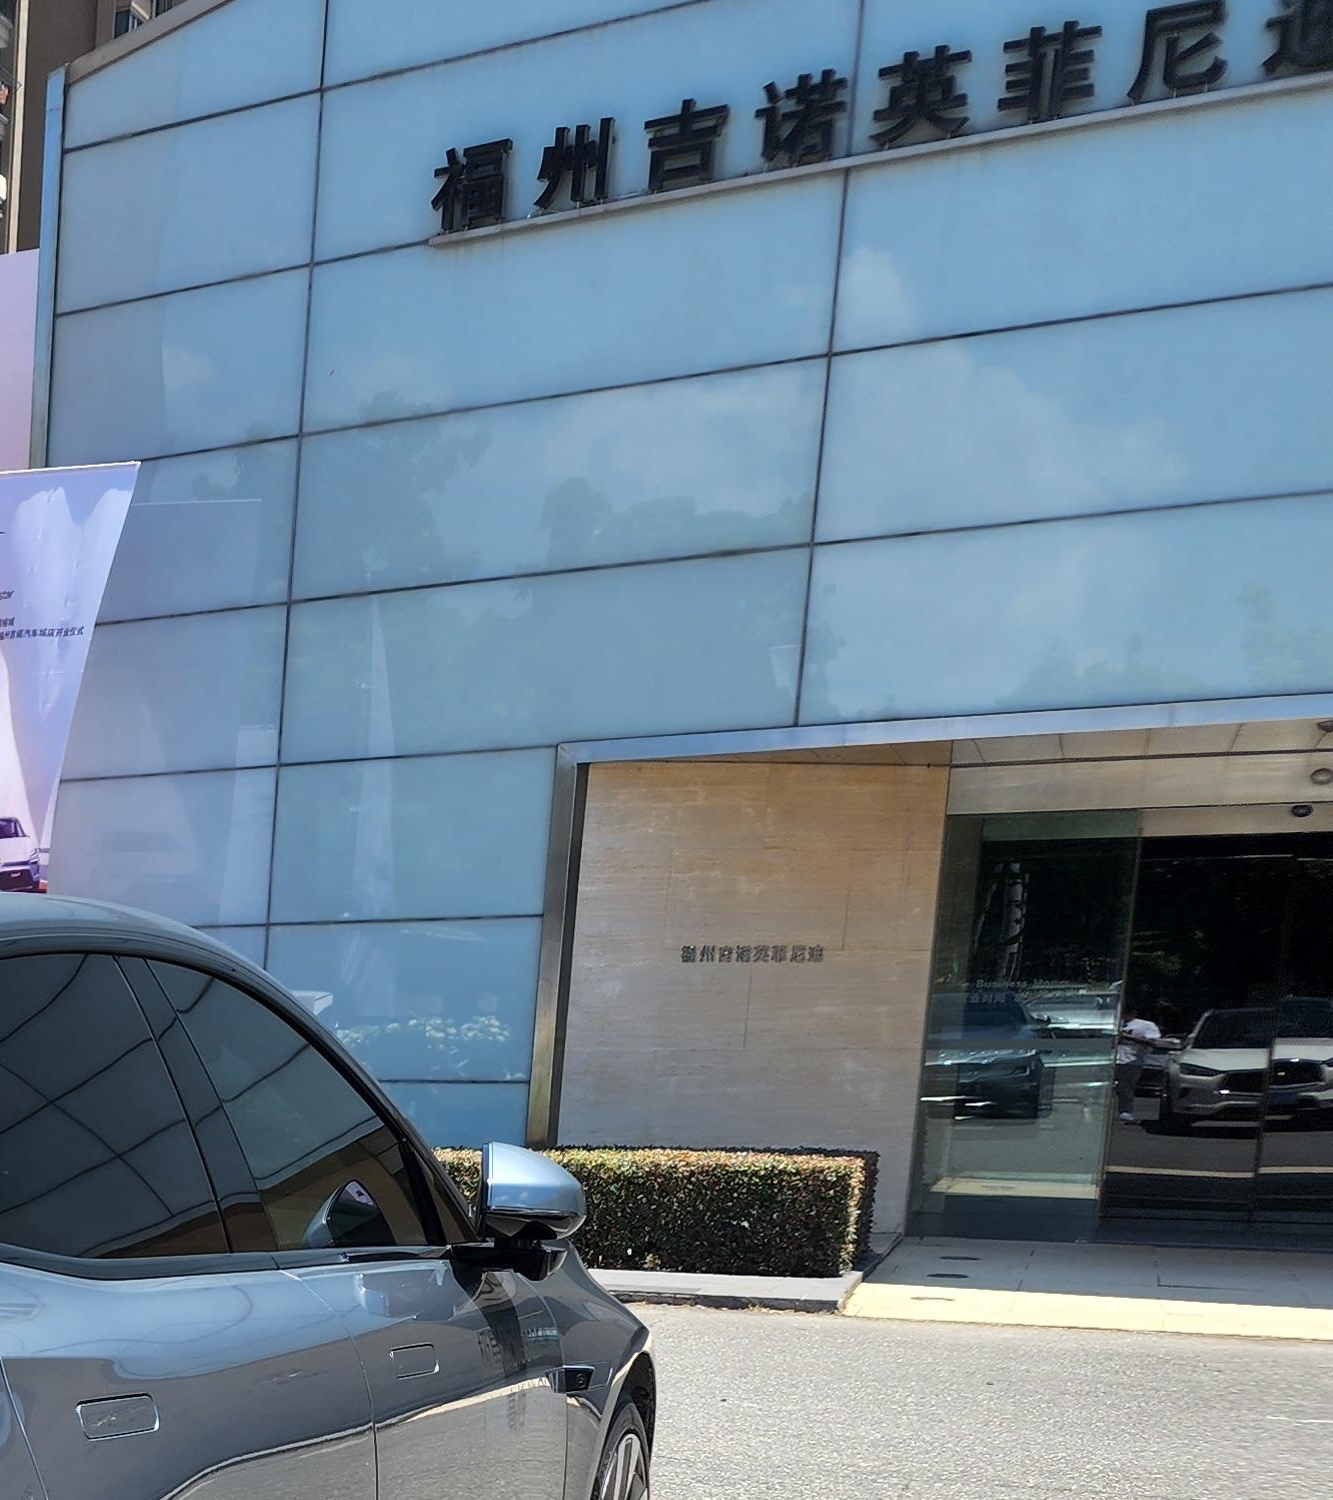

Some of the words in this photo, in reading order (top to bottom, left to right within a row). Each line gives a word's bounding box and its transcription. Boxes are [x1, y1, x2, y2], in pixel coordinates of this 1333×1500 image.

[430, 0, 1333, 232] 福州吉诺英菲尼迪
